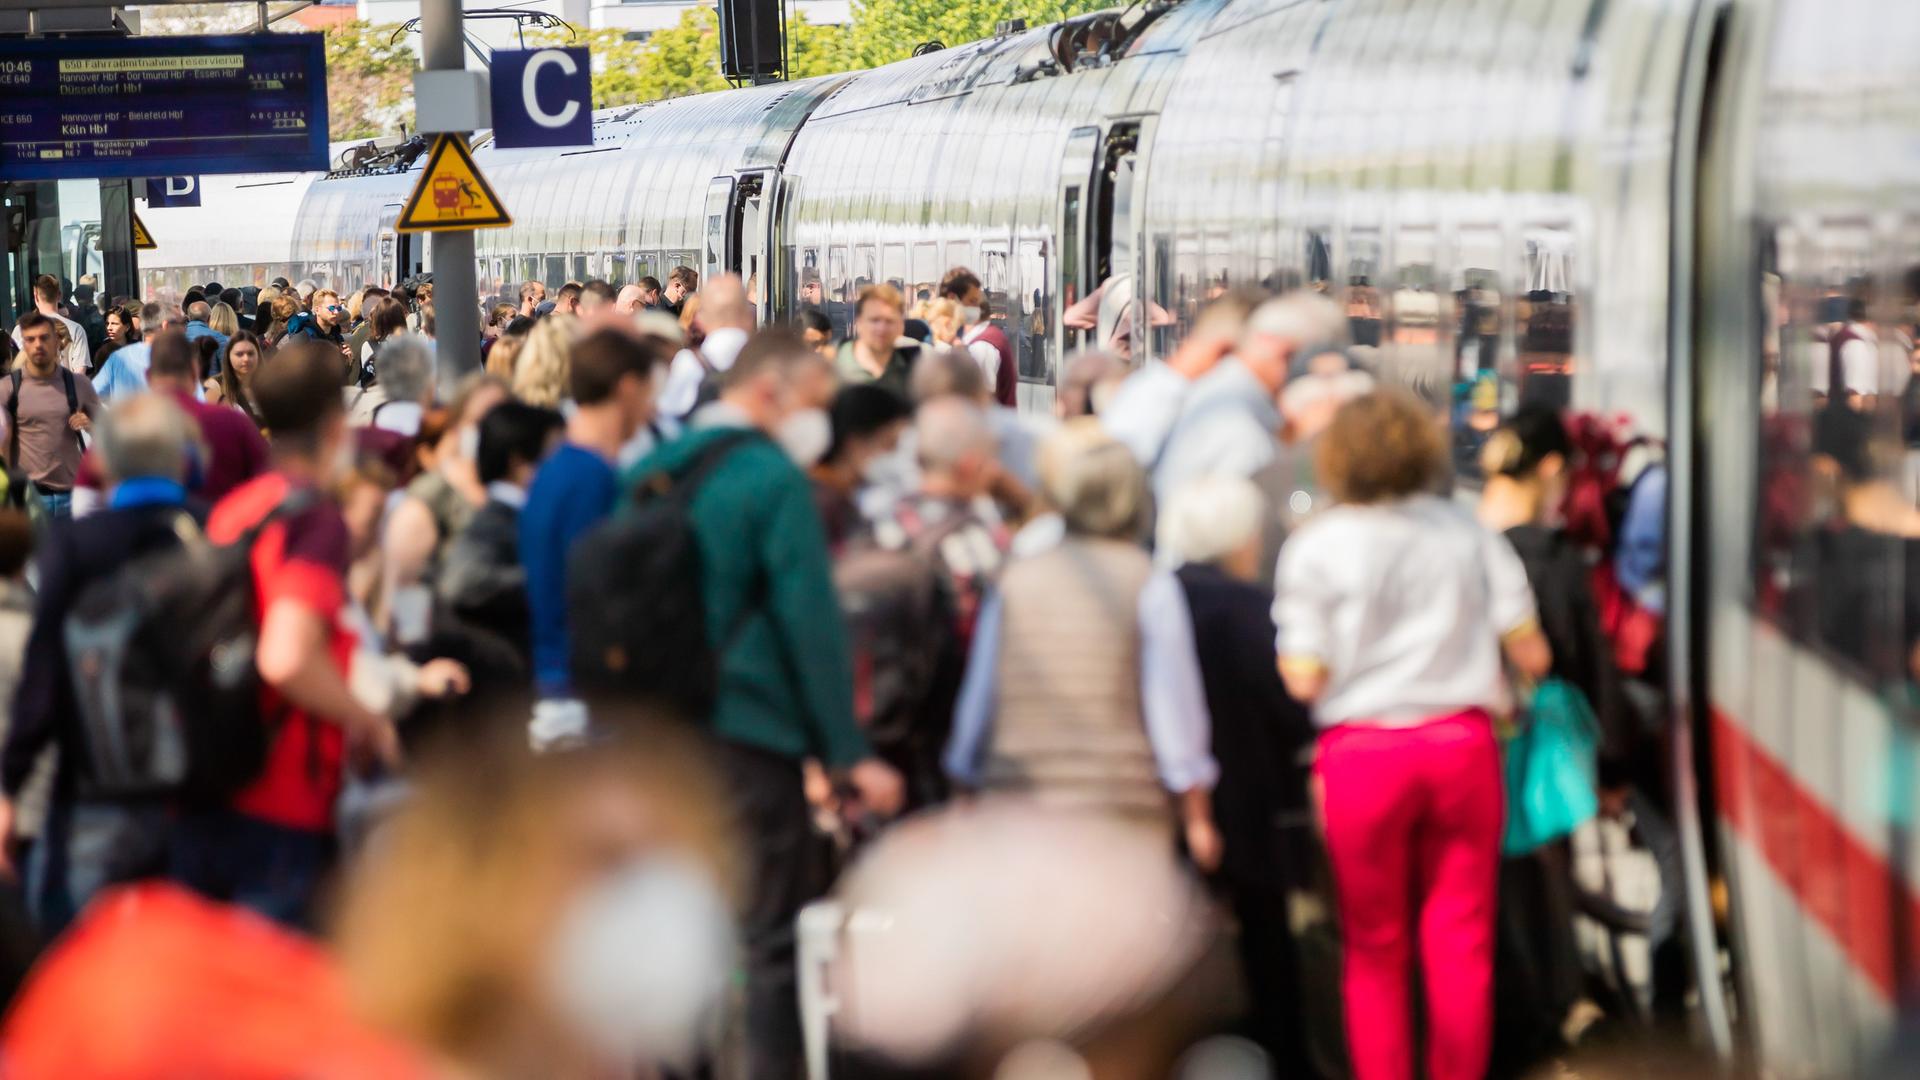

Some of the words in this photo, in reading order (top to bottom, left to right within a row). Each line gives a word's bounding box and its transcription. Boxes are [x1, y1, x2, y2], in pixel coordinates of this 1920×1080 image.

[0, 61, 31, 73] 10:46
[60, 72, 99, 82] Hannover
[102, 71, 117, 81] Hbf
[127, 70, 168, 80] Dortmund
[170, 70, 185, 79] Hbf
[195, 69, 220, 79] Essen
[222, 68, 237, 78] Hbf
[60, 84, 119, 95] Düsseldorf
[123, 83, 141, 93] Hbf
[522, 49, 580, 128] C
[0, 114, 14, 124] ICE
[61, 113, 102, 122] Hannover
[105, 112, 120, 121] Hbf
[128, 110, 167, 121] Bielefeld
[169, 110, 184, 119] Hbf
[62, 124, 87, 135] Köln
[90, 123, 108, 134] Hbf
[136, 139, 149, 147] Hbf
